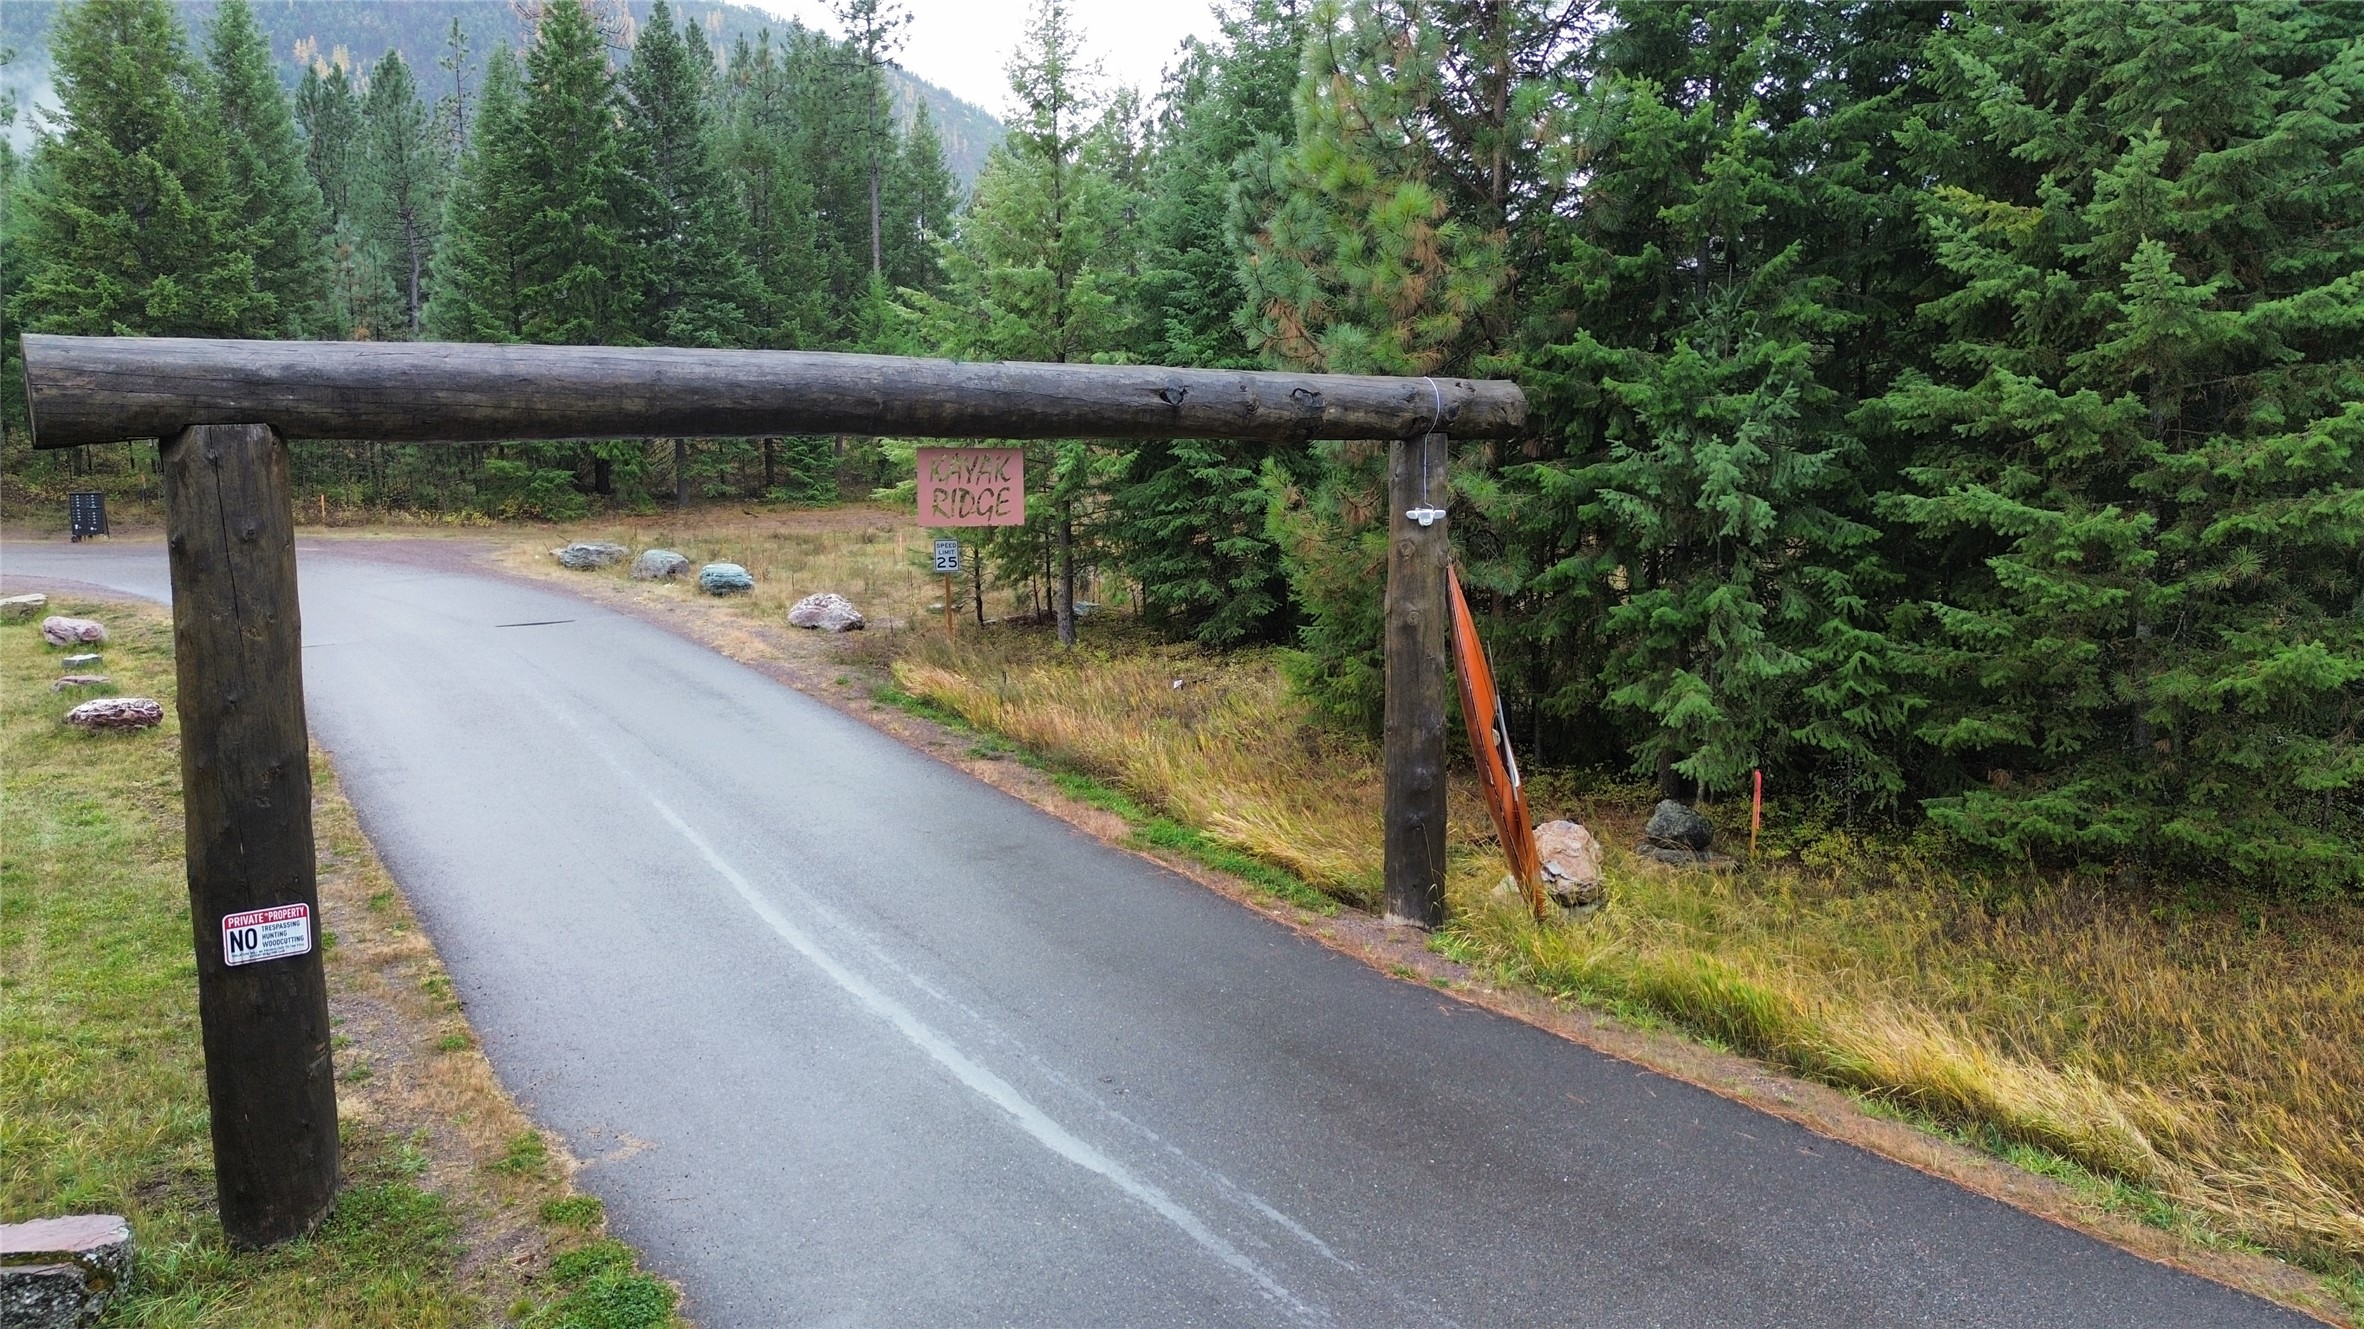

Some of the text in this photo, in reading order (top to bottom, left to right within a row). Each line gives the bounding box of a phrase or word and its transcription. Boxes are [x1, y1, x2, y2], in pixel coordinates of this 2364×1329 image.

[930, 453, 1012, 485] KAYAK
[932, 487, 1011, 521] RIDGE
[937, 557, 957, 568] 25
[228, 907, 304, 928] PRIVATE PROPERTY
[261, 920, 300, 932] TRESPASSING
[229, 928, 258, 953] NO
[262, 930, 287, 940] HUNTING
[262, 935, 304, 948] WOODCUTTING
